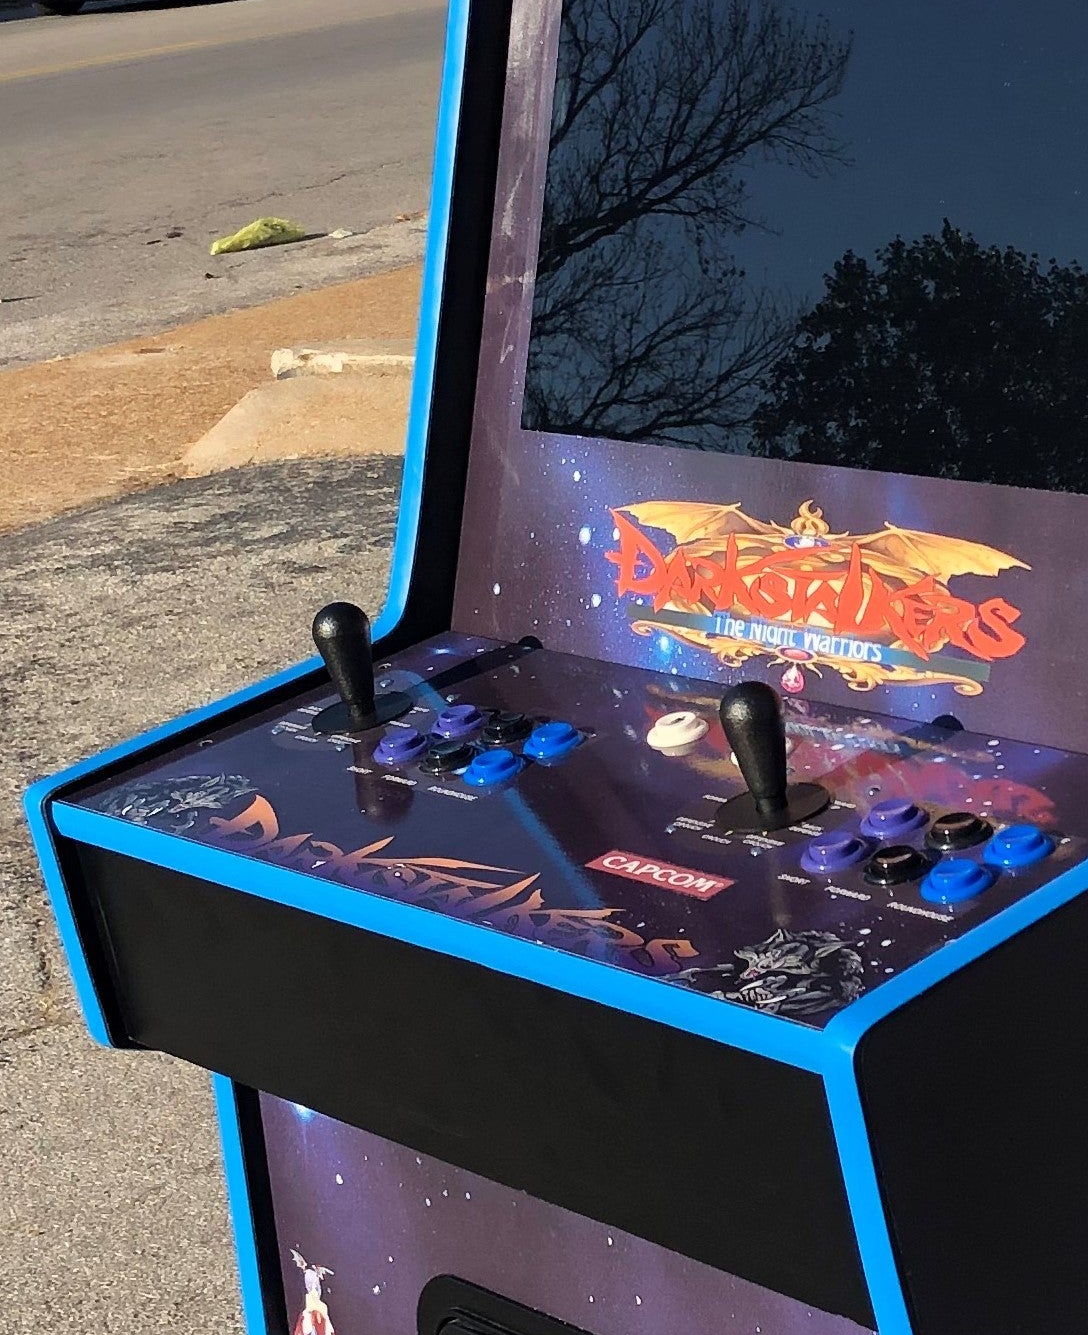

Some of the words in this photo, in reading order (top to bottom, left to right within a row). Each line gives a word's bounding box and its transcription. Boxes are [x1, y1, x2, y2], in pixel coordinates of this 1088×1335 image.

[605, 508, 1026, 662] DARKSTALKERS
[715, 615, 745, 638] The
[803, 630, 882, 662] Warriors
[602, 855, 717, 893] CAPCOM
